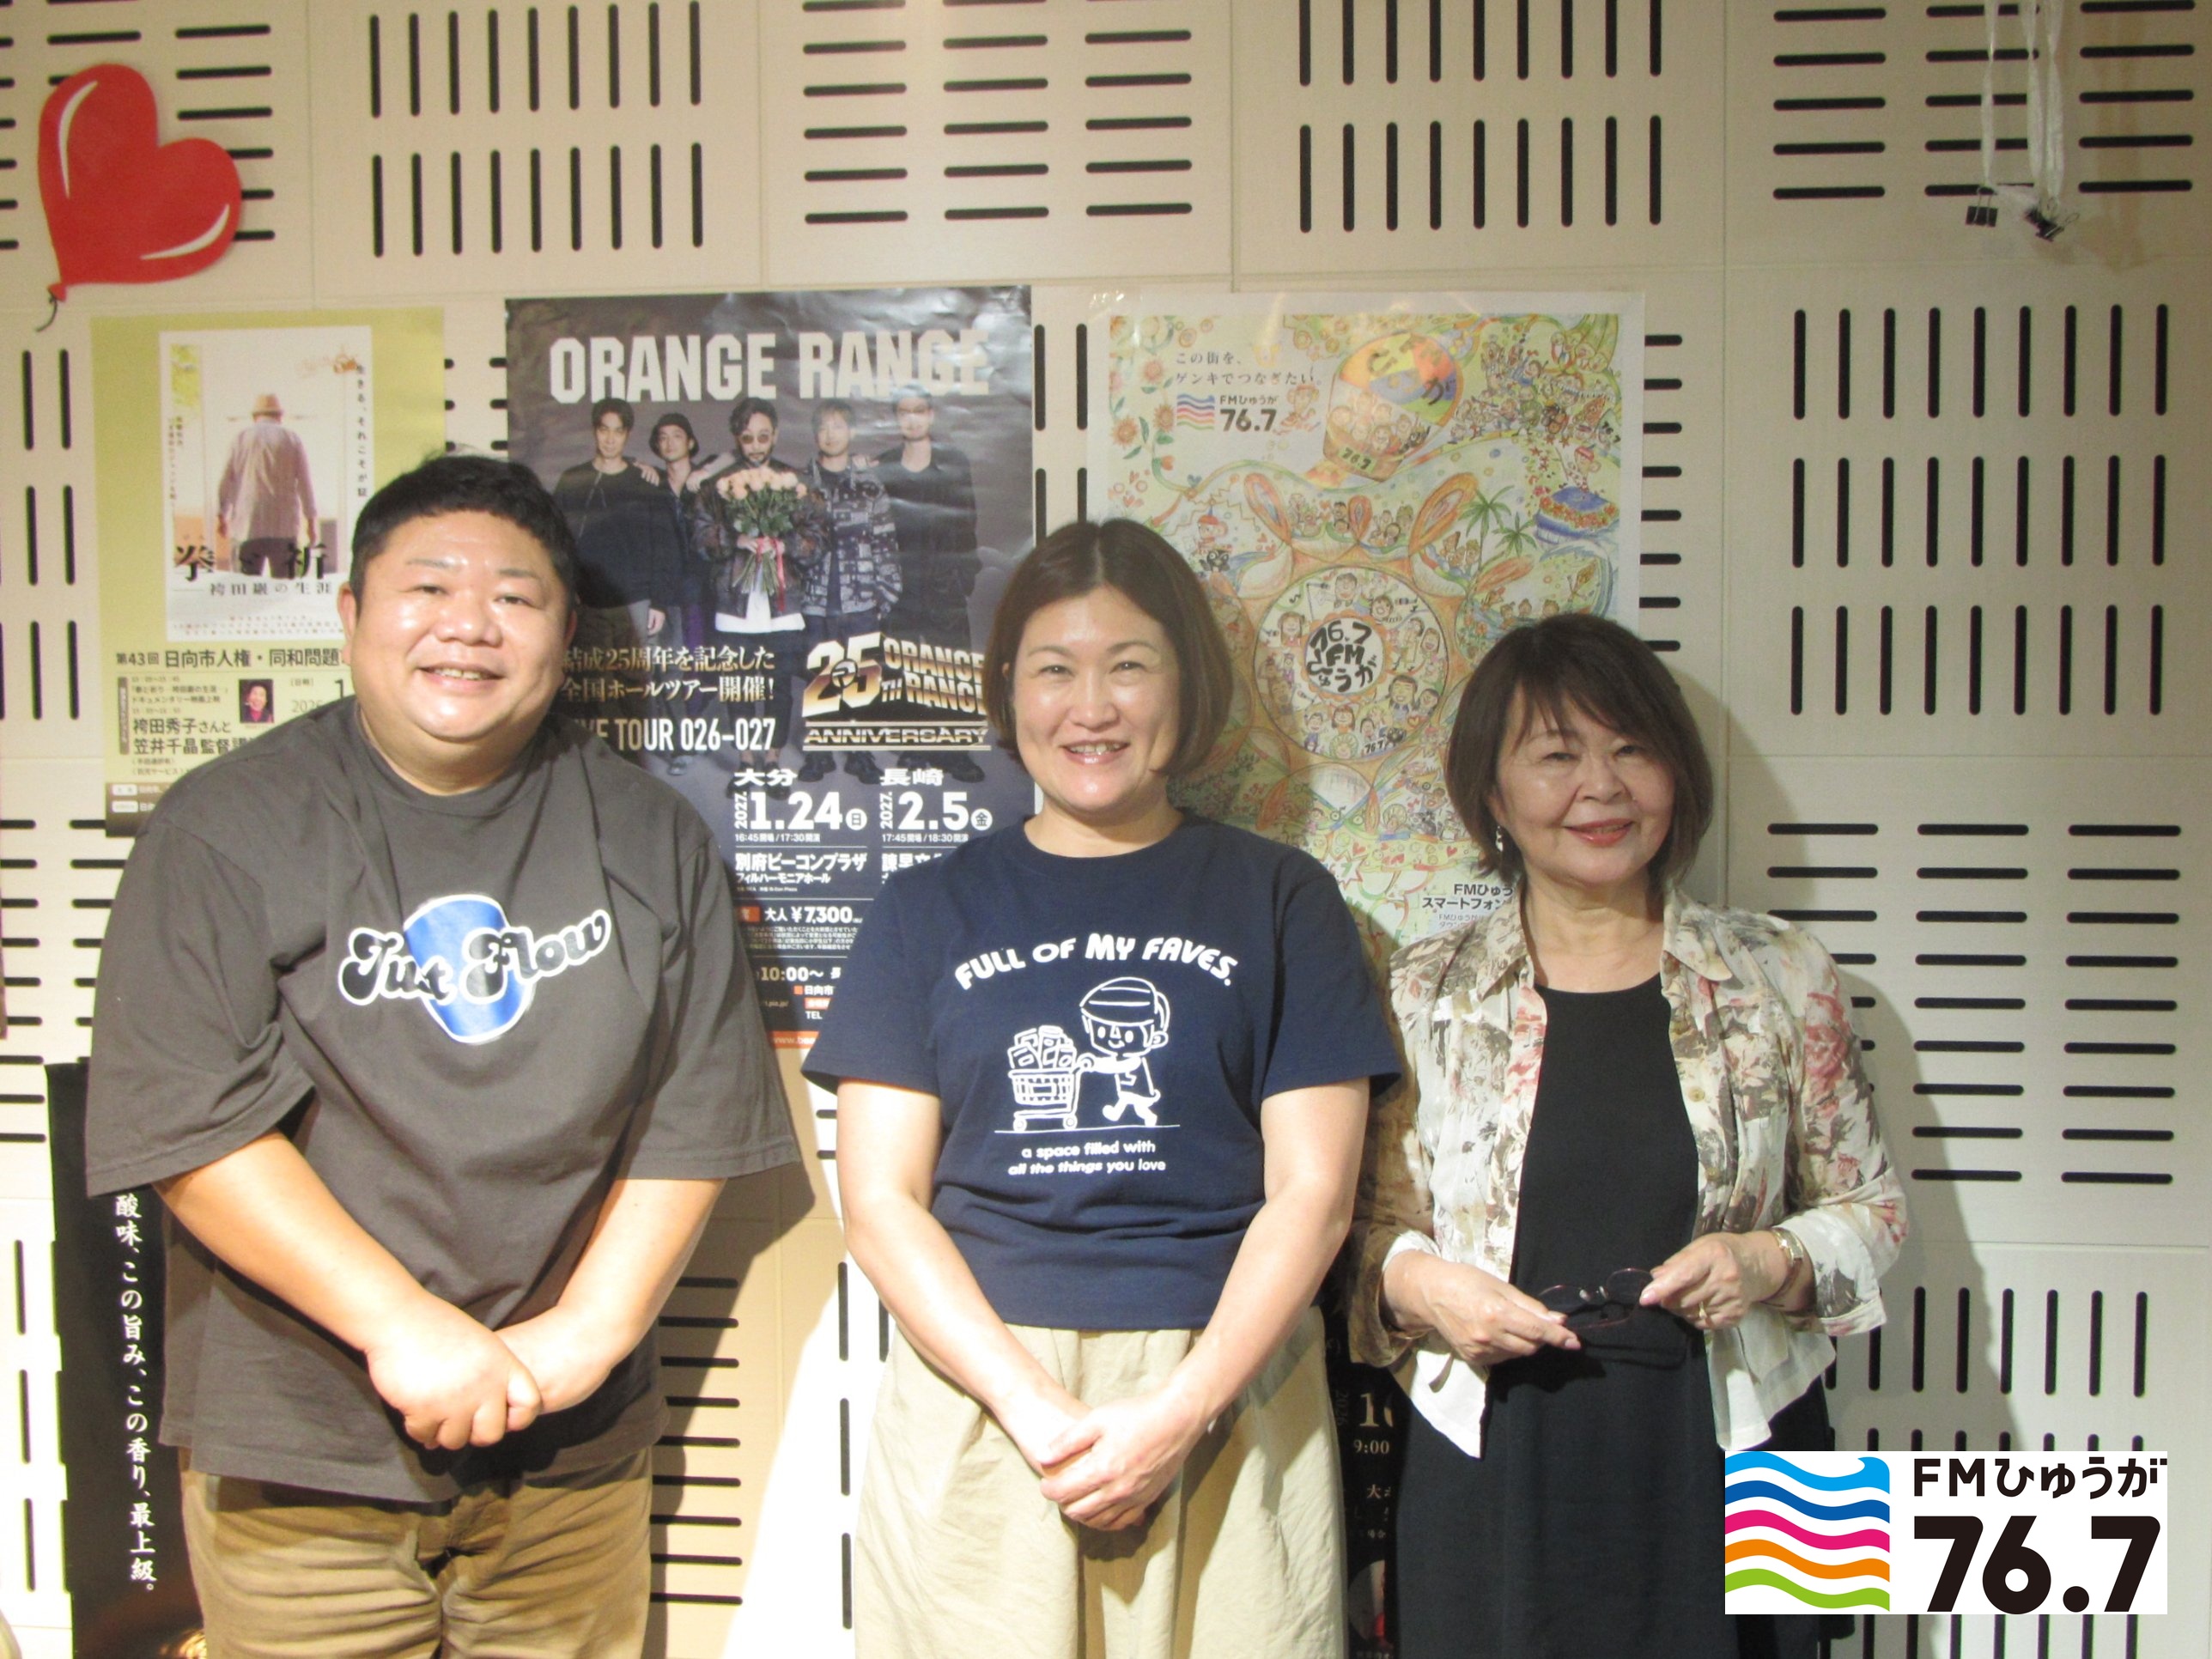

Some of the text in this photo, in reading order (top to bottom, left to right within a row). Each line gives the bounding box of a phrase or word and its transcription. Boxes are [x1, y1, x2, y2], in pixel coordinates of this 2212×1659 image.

[550, 330, 989, 404] ORANGE RANGE
[1176, 351, 1242, 365] この街を、
[1219, 394, 1279, 405] FMひゅうが
[1219, 409, 1277, 432] 76.7
[115, 648, 344, 667] 第43回 日向市人権・同和問題
[1326, 642, 1365, 666] FM
[802, 631, 882, 718] 25
[134, 718, 231, 734] 袴田秀子さんと
[615, 718, 674, 751] TOUR
[680, 718, 776, 751] 026-027
[804, 727, 988, 744] ANNIVERSARY
[734, 769, 798, 787] 大分
[879, 768, 944, 786] 長崎
[734, 791, 748, 830] 2027.
[750, 791, 843, 830] 1.24
[879, 792, 893, 830] 2027.
[898, 791, 990, 831] 2.5 金
[735, 852, 867, 872] 別府ビーコンプラザ
[736, 872, 831, 884] フィルハーモニアホール
[764, 908, 788, 921] 大人
[791, 906, 853, 924] ¥7,300
[459, 909, 611, 1005] Flow
[955, 933, 1238, 990] FULL OF MY FAVES.
[805, 1012, 823, 1020] TEL
[1021, 1140, 1156, 1161] a space filled with
[1007, 1159, 1166, 1176] all the things you love
[115, 1193, 157, 1590] 酸味、この旨み、この香り、最上級。
[1354, 1439, 1389, 1454] 9:00
